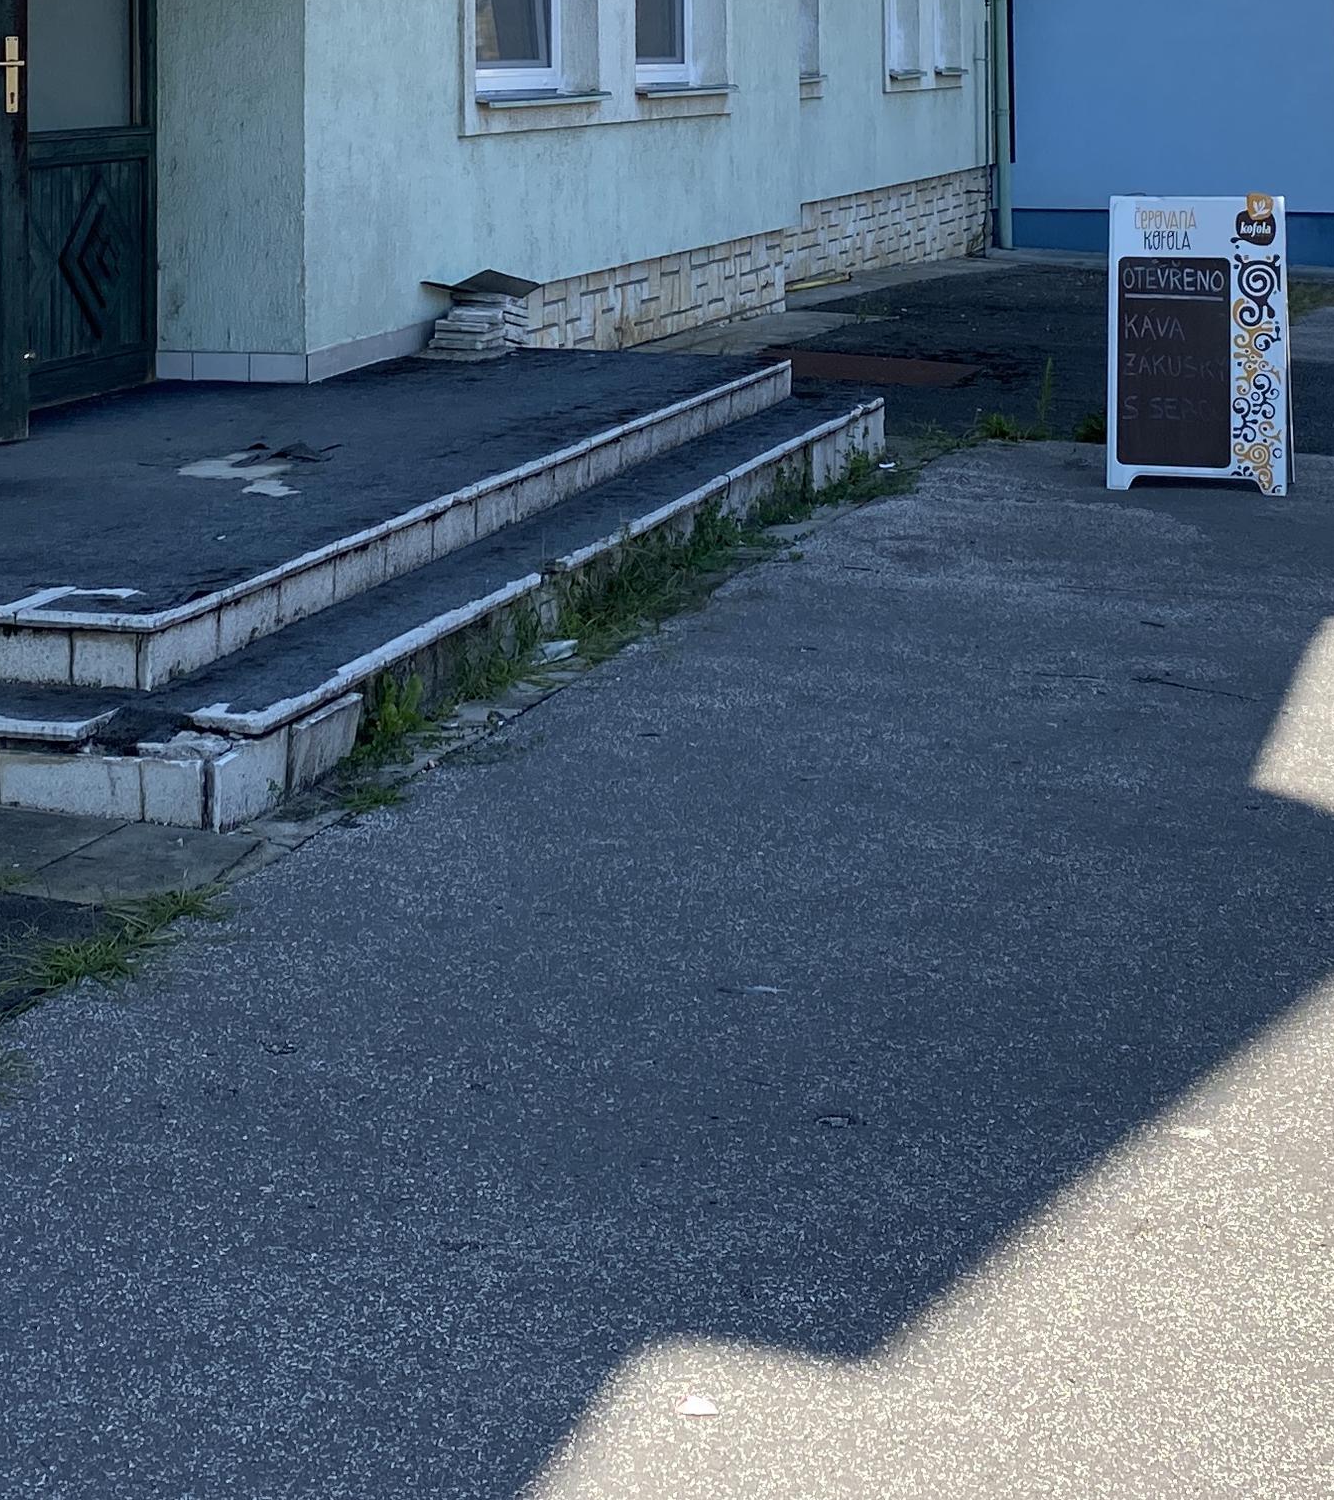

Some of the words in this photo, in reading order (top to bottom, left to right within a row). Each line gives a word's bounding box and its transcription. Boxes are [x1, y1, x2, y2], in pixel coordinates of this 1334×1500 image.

[1240, 221, 1272, 238] kofola
[1143, 230, 1192, 250] KOFOLA
[1124, 309, 1185, 341] KÁVA
